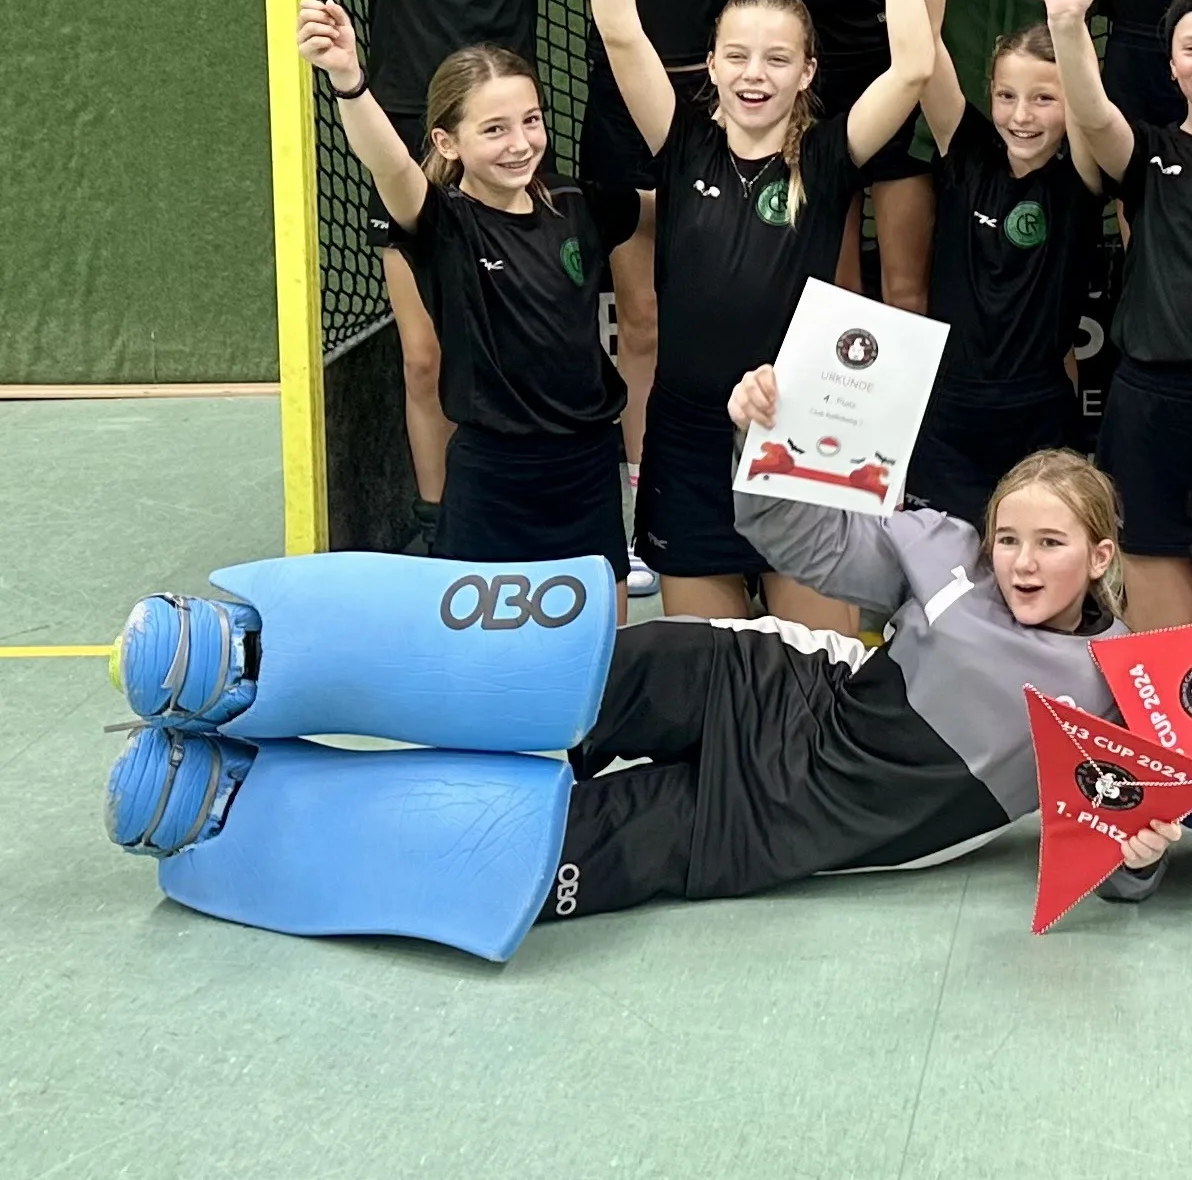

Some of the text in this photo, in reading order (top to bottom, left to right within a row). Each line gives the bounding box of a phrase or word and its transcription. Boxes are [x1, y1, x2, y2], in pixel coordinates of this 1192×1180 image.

[440, 574, 587, 631] OBO
[1128, 663, 1178, 749] CUP 2024
[1093, 735, 1135, 758] CUP
[1136, 754, 1188, 784] 2024
[1056, 801, 1129, 845] 1. Platz
[556, 862, 580, 915] OBO
